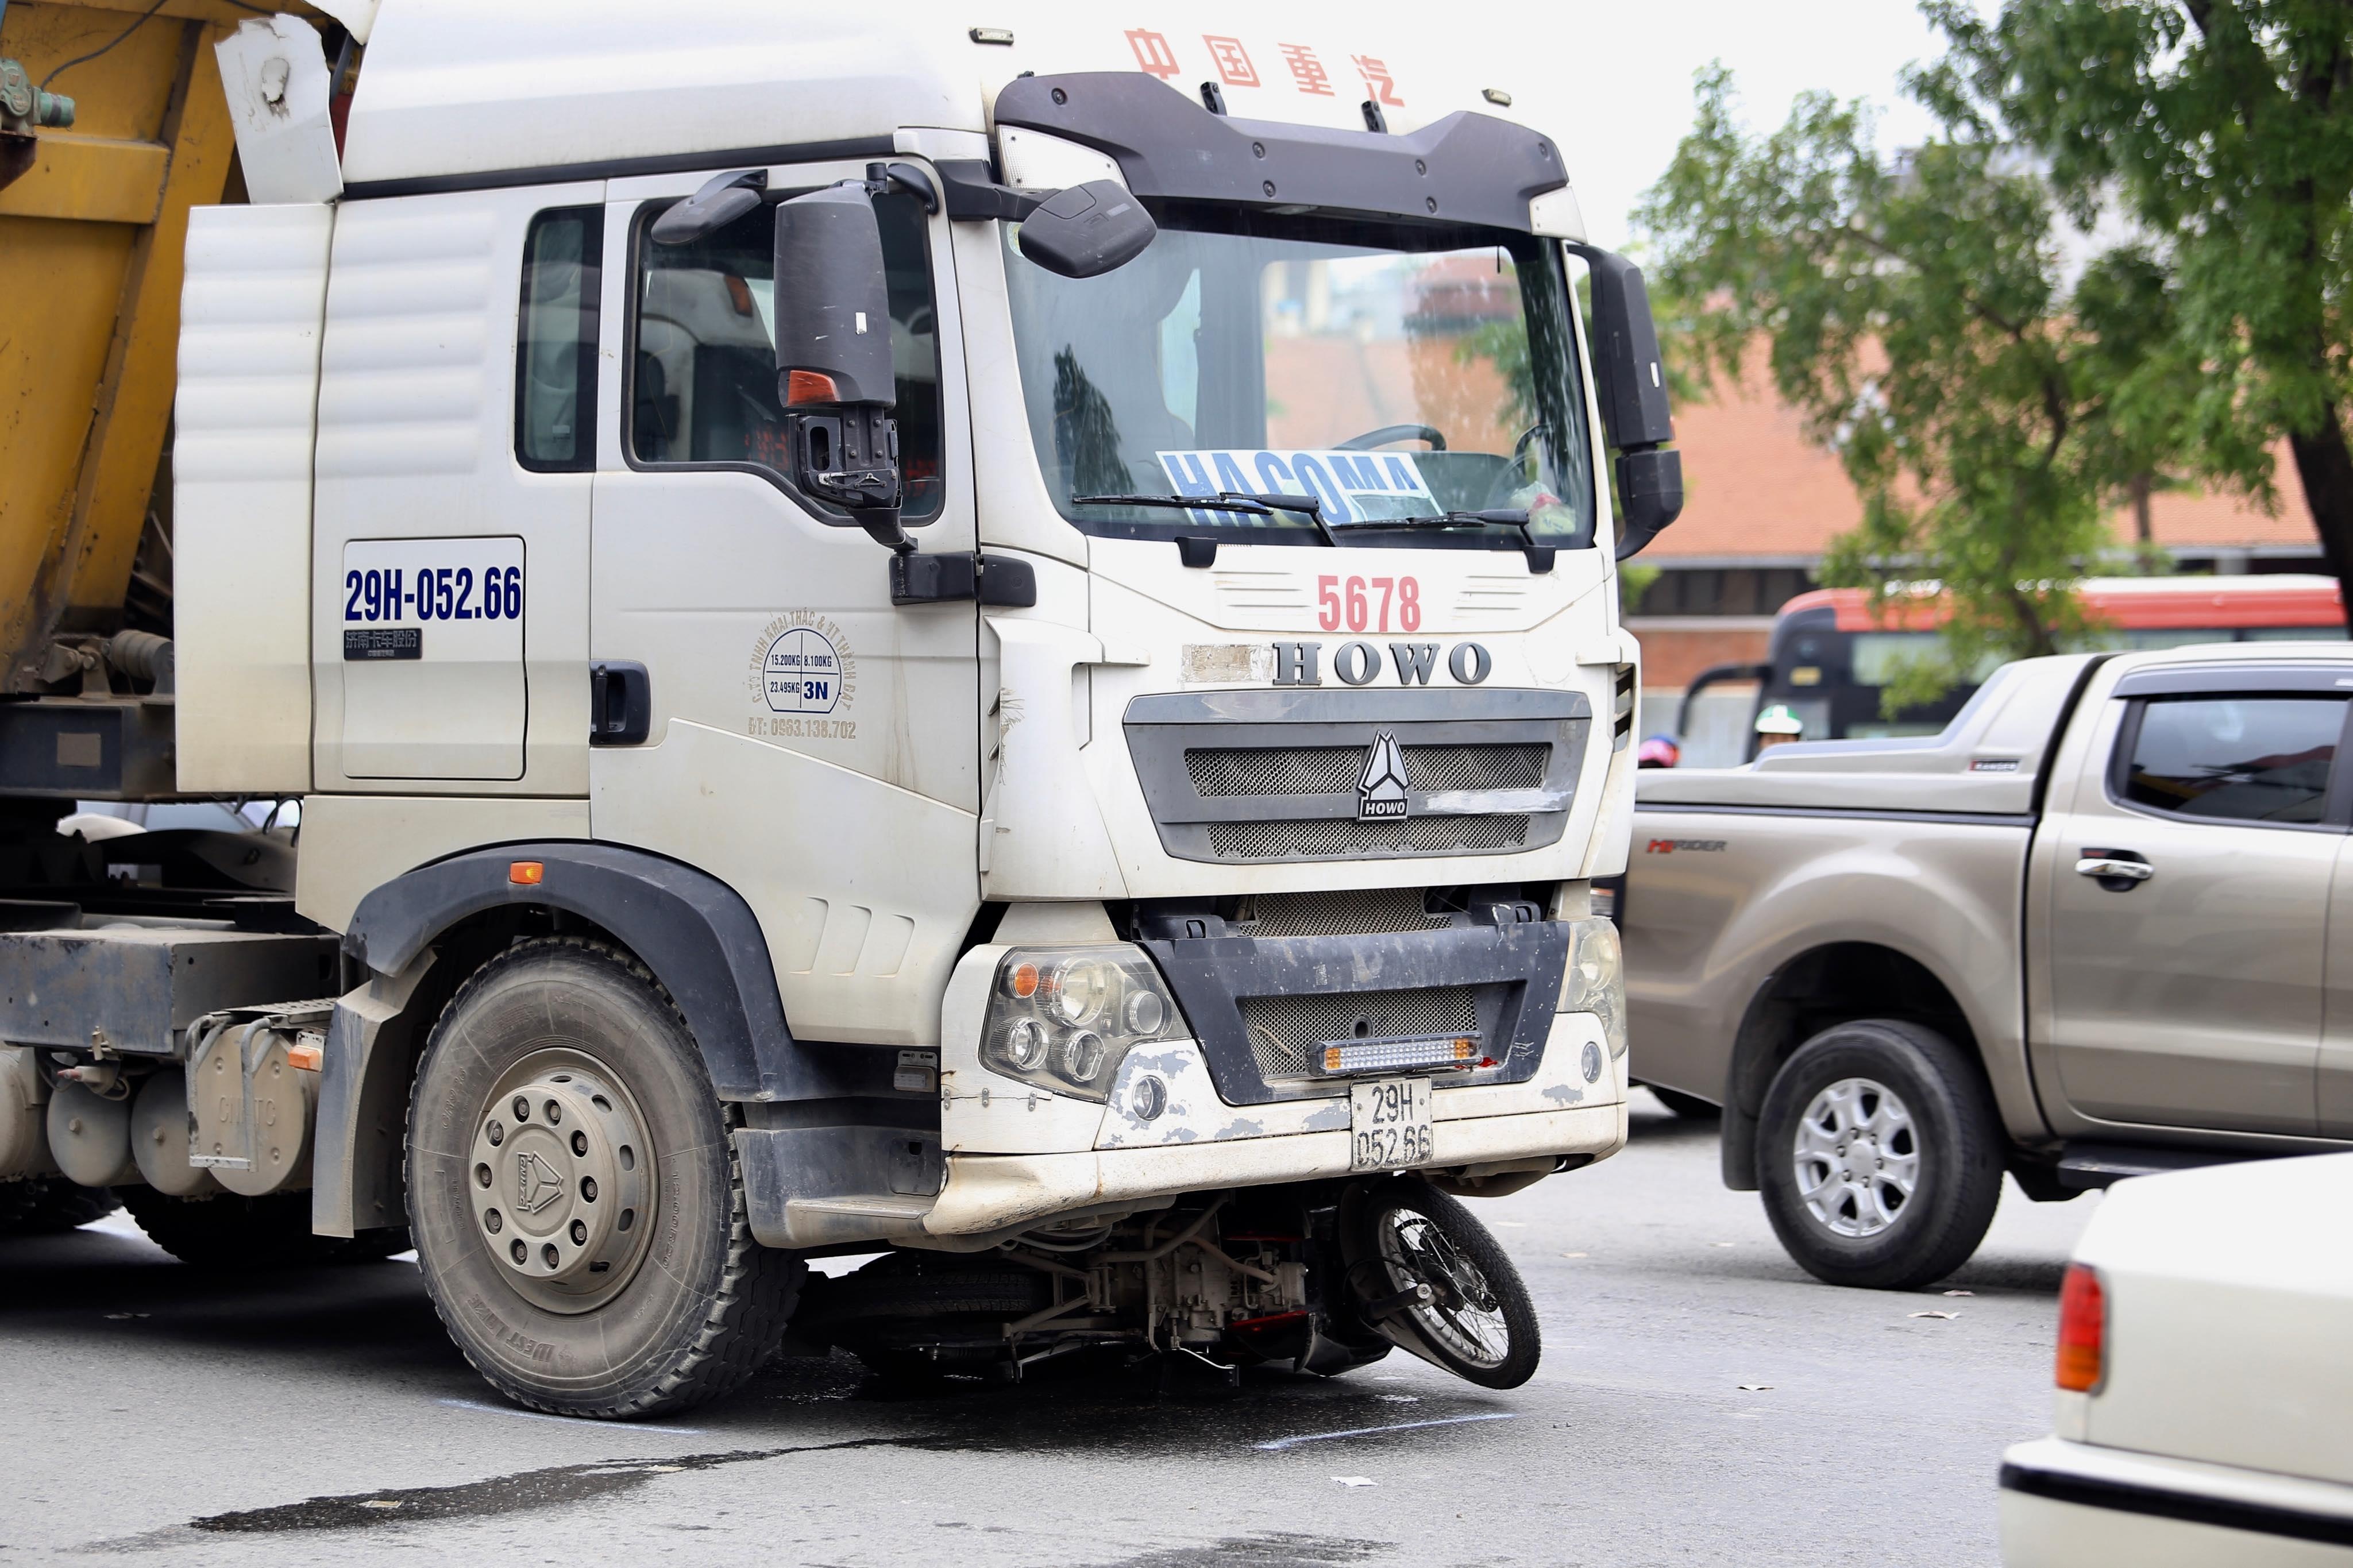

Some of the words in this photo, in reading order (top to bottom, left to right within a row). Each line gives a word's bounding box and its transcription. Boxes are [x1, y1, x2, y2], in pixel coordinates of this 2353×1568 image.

[1124, 28, 1405, 107] 中国重汽
[345, 566, 521, 621] 29H-052.66
[1318, 575, 1421, 632] 5678
[346, 631, 417, 649] 济南卡车股份
[749, 637, 769, 670] TNHH
[772, 654, 800, 666] 15.200KG
[804, 655, 832, 667] 8.100KG
[1272, 641, 1492, 685] HOWO
[770, 681, 800, 693] 23.495KG
[804, 681, 828, 700] 3N
[771, 718, 856, 739] 0963.138.702
[1365, 802, 1405, 814] HOWO
[1372, 1083, 1413, 1124] 29H
